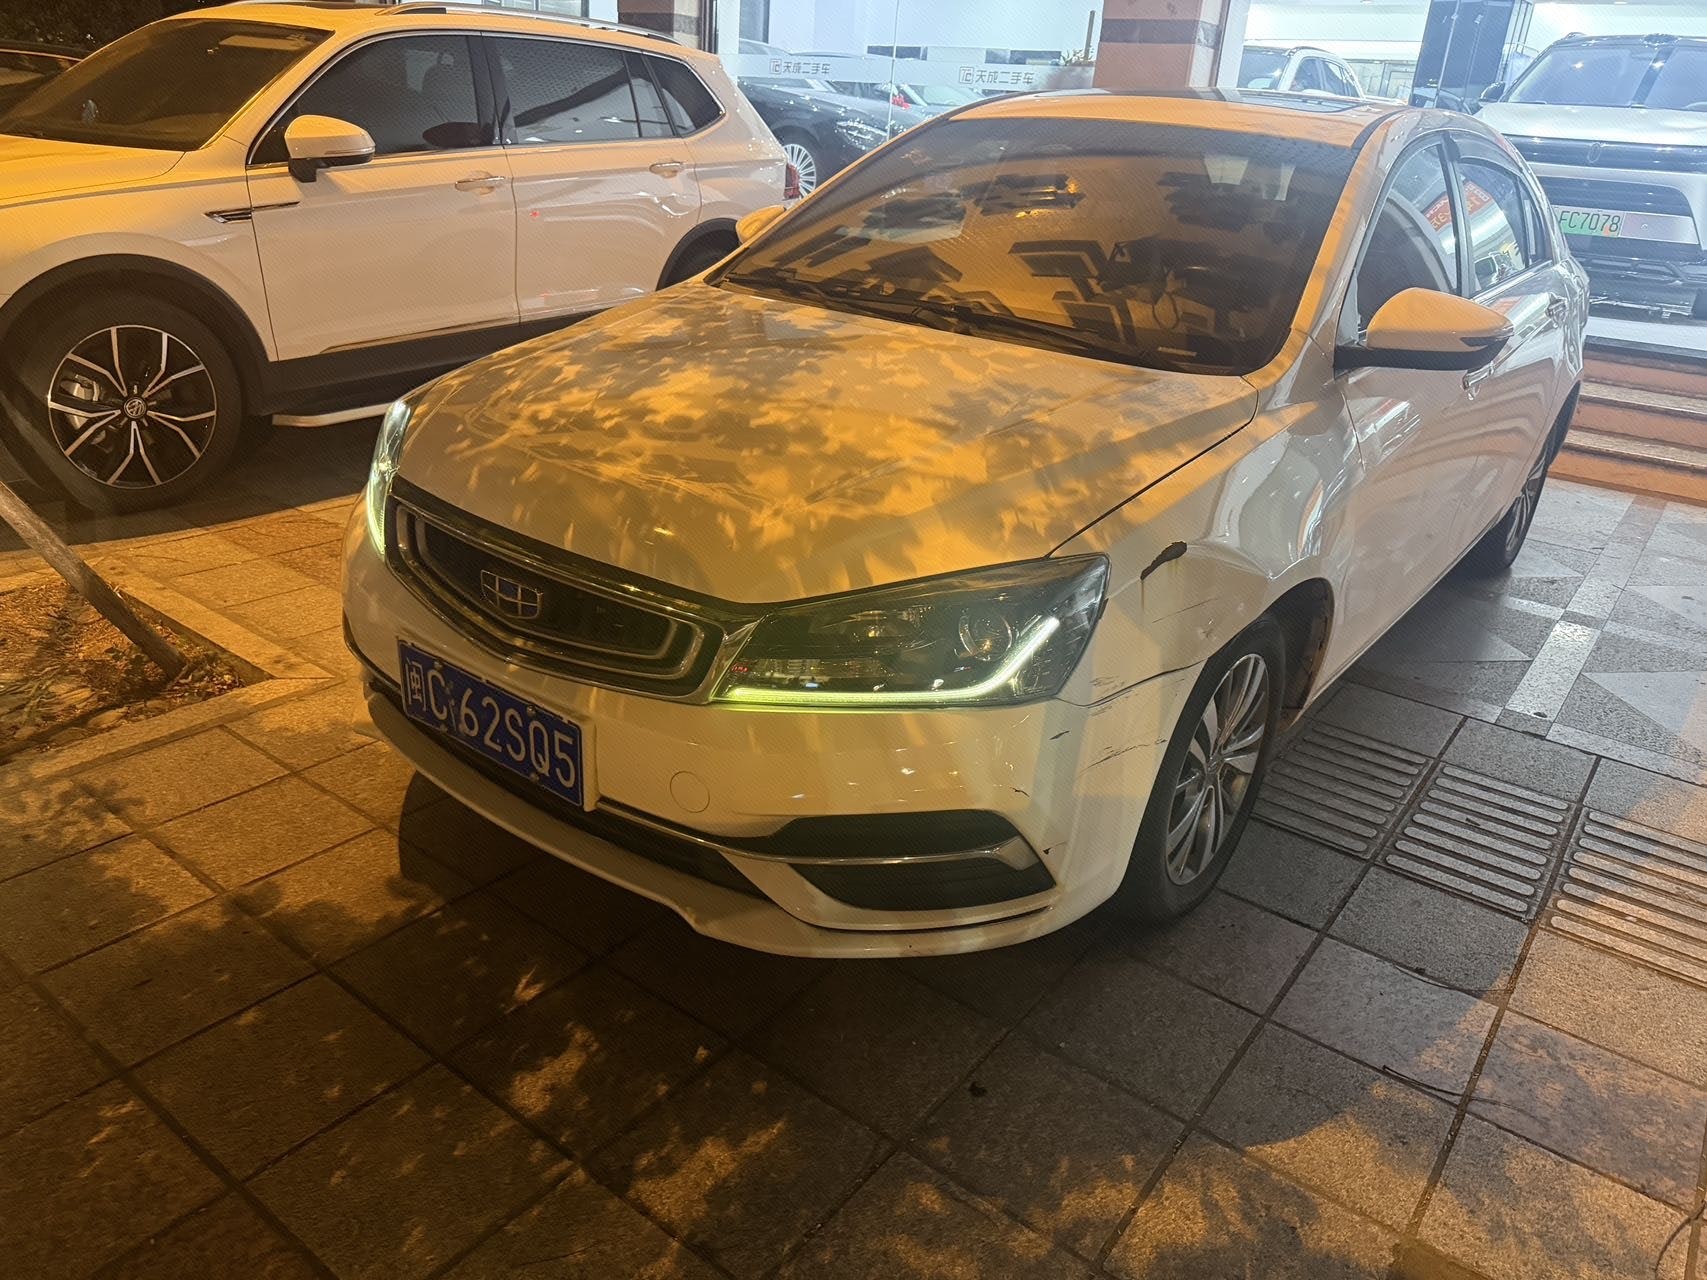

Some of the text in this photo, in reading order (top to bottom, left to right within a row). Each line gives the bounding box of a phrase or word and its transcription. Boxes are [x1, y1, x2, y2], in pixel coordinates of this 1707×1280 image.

[783, 61, 831, 75] 天成二手车
[975, 69, 1035, 85] 天成二手车
